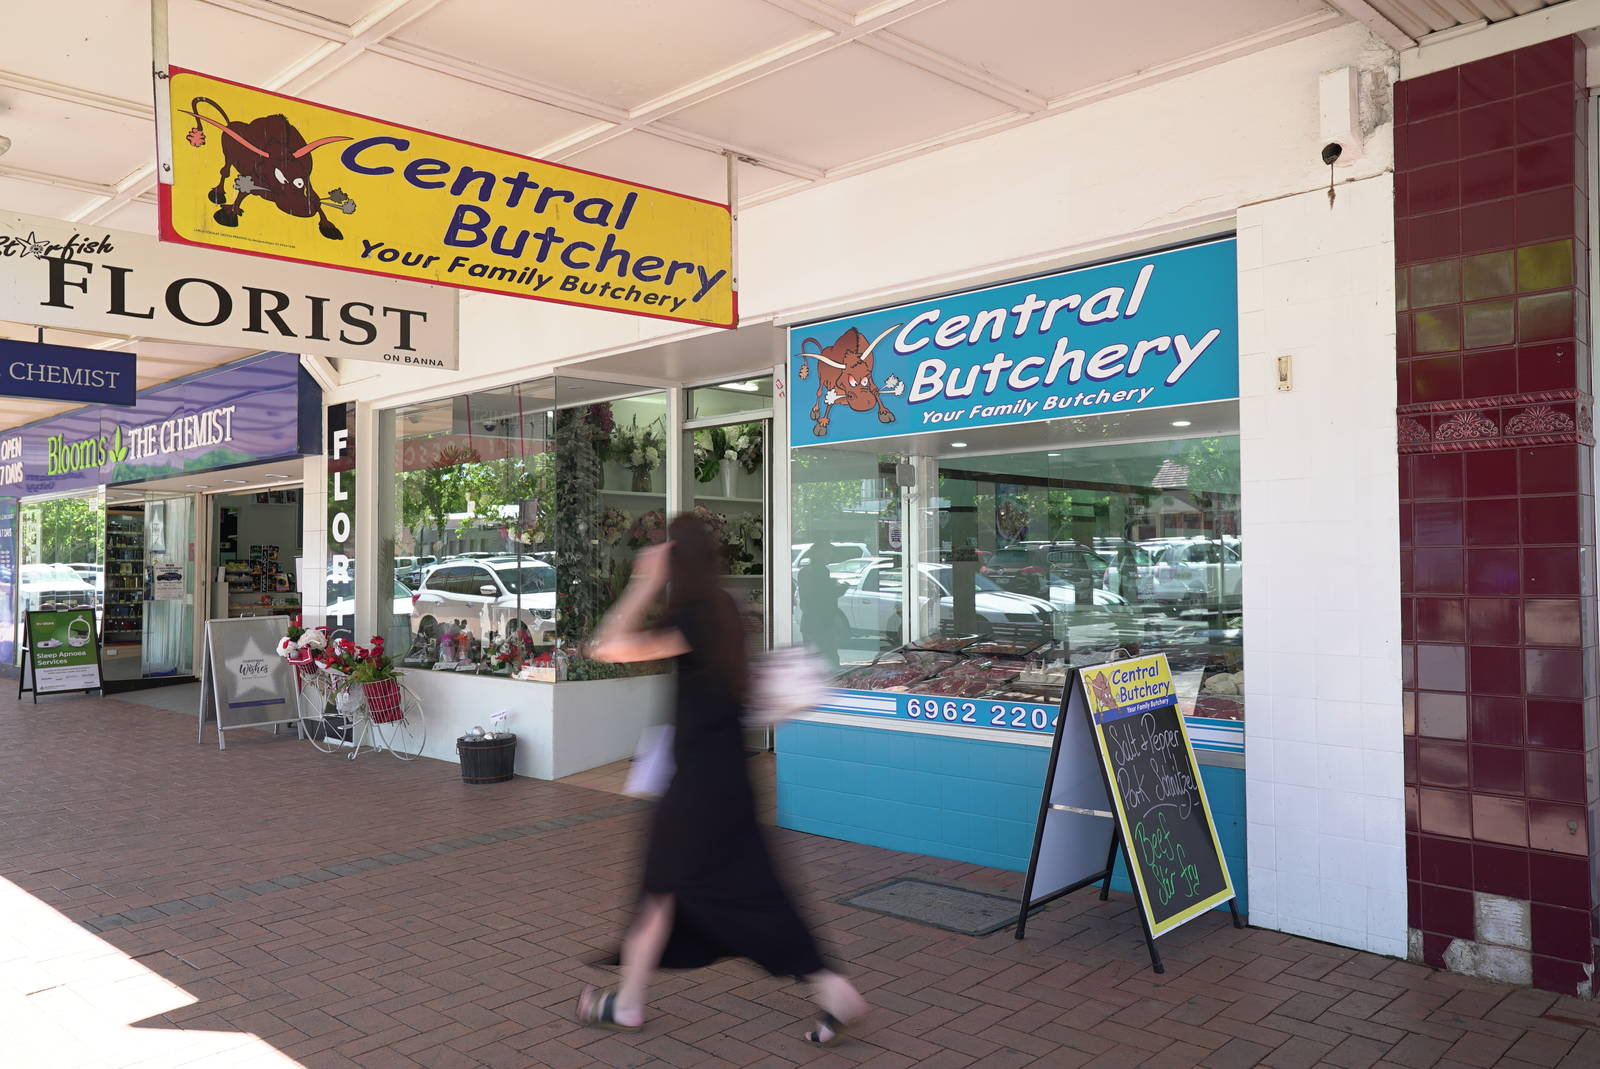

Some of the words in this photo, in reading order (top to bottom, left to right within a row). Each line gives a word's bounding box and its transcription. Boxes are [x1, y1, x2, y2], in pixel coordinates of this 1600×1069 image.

[341, 136, 638, 231] Central
[444, 204, 727, 303] Butchery
[360, 240, 443, 270] Your
[447, 257, 553, 292] Family
[560, 274, 687, 313] Butchery
[40, 256, 428, 351] FLORIST
[893, 264, 1155, 356] Central
[9, 361, 120, 389] CHEMIST
[383, 353, 400, 362] ON
[404, 356, 444, 367] BANNA
[907, 328, 1220, 405] Butchery
[922, 409, 964, 426] Your
[969, 400, 1037, 421] Family
[1042, 385, 1156, 412] Butchery
[1, 436, 22, 460] OPEN
[47, 432, 107, 475] Blooms
[128, 424, 158, 460] THE
[160, 405, 235, 454] CHEMIST
[6, 461, 23, 484] DAYS
[36, 652, 58, 661] Sleep
[59, 650, 87, 660] Apnoea
[1112, 660, 1159, 685] Central
[906, 698, 977, 724] 6962
[1120, 681, 1170, 703] Butchery
[1126, 706, 1137, 714] Your
[1137, 703, 1151, 712] Family
[1151, 699, 1169, 708] Butchery
[1109, 724, 1141, 766] Salt
[1141, 712, 1179, 763] Pepper
[1117, 765, 1151, 810] Pork
[1150, 753, 1198, 819] Schnitzel
[1134, 811, 1175, 867] Beef
[1151, 863, 1176, 906] Stir
